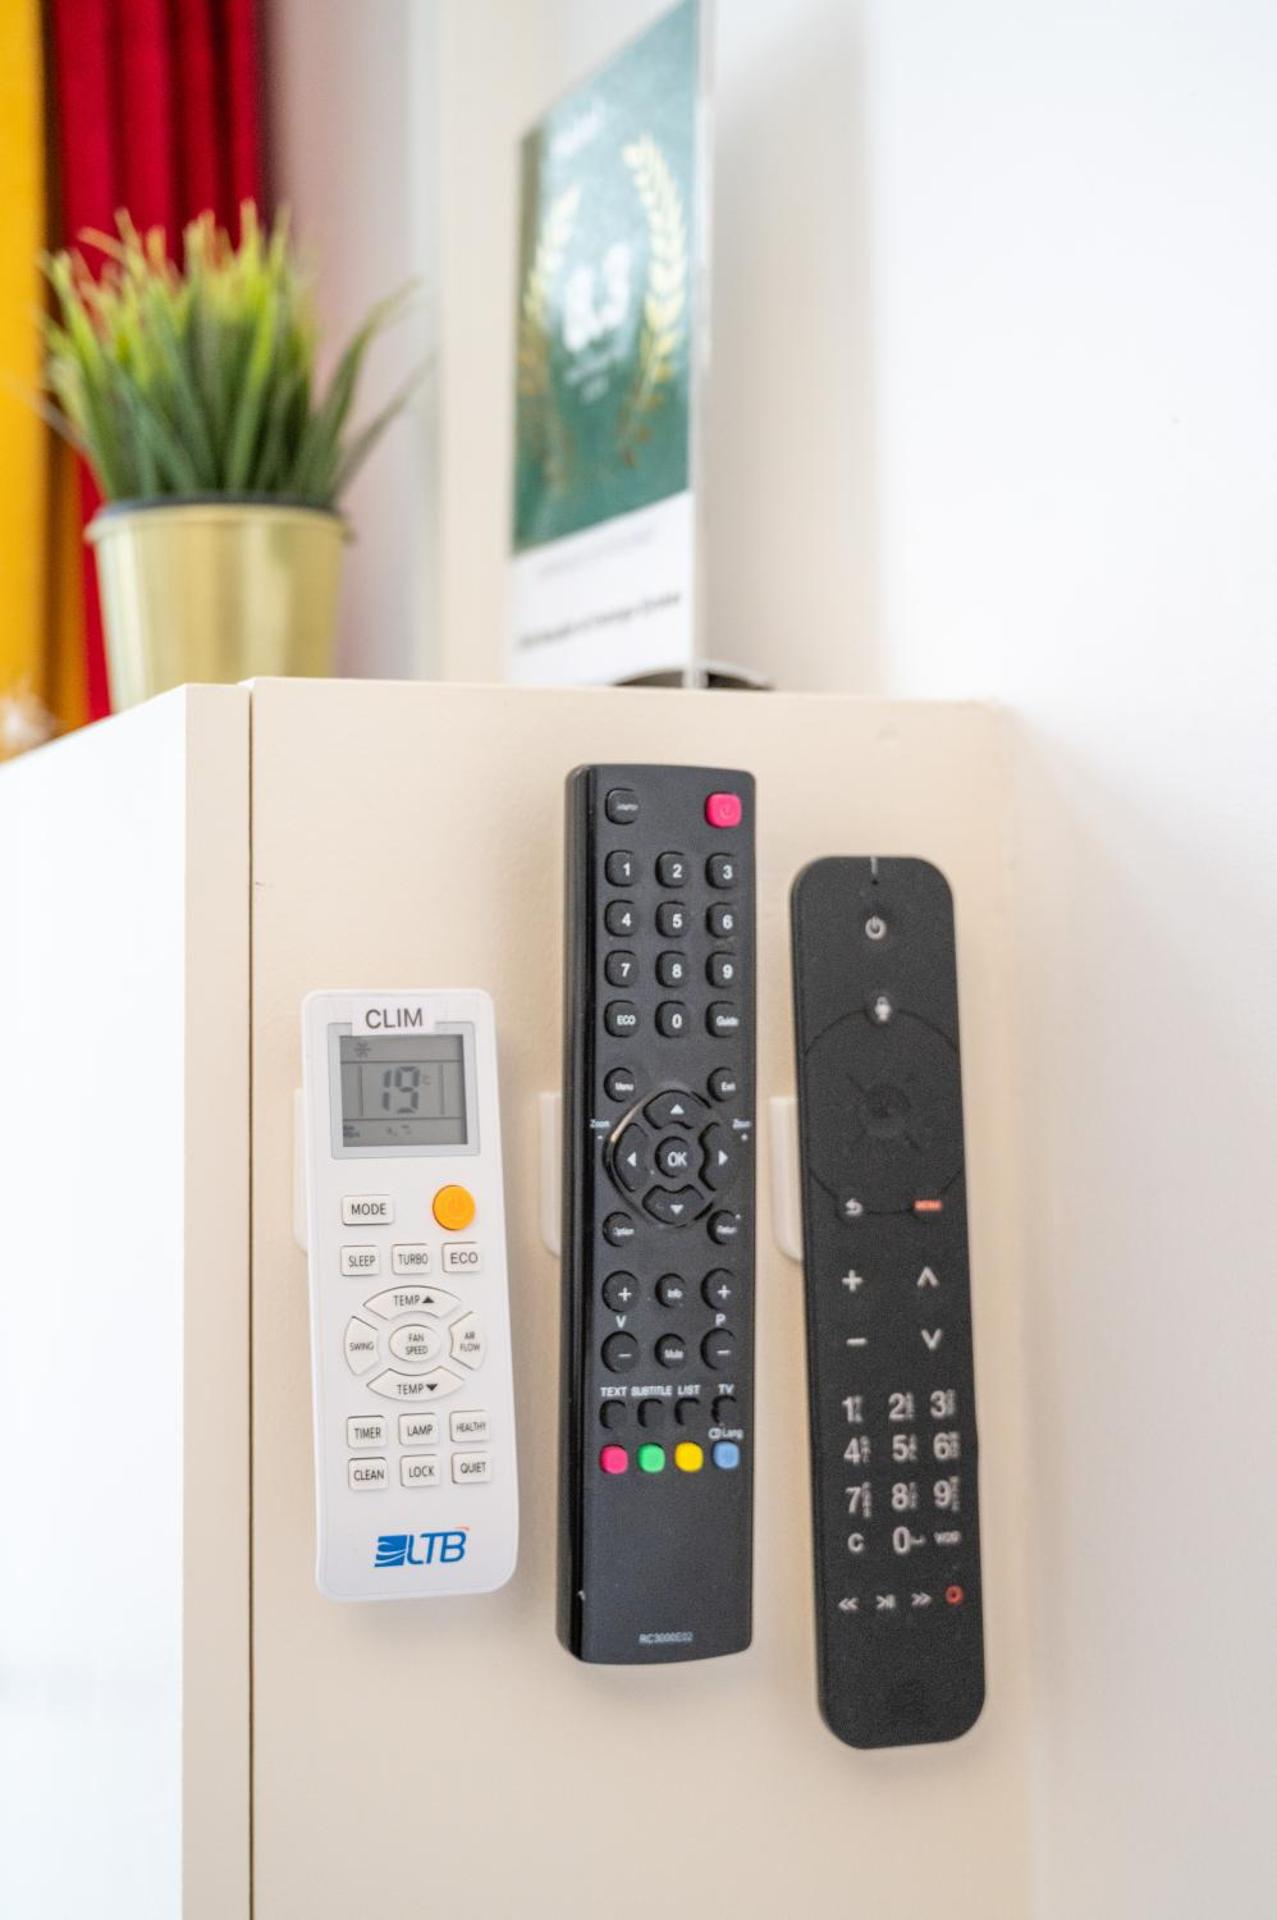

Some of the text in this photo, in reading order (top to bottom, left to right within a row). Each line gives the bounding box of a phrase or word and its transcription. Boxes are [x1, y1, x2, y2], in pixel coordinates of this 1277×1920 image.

[622, 862, 631, 877] 1
[672, 864, 683, 878] 2
[722, 865, 733, 880] 3
[621, 912, 632, 927] 4
[672, 913, 683, 928] 5
[722, 914, 733, 930] 6
[621, 962, 631, 977] 7
[672, 963, 682, 979] 8
[722, 964, 733, 979] 9
[364, 1007, 424, 1030] CLIM
[616, 1015, 636, 1026] ECO
[671, 1013, 682, 1029] 0
[382, 1065, 421, 1115] 19
[667, 1151, 688, 1167] OK
[351, 1202, 387, 1217] MODE
[348, 1254, 376, 1268] SLEEP
[398, 1252, 429, 1266] TURBO
[450, 1251, 478, 1265] ECO
[393, 1294, 420, 1307] TEMP
[615, 1315, 627, 1328] V
[715, 1313, 727, 1327] P
[408, 1333, 425, 1343] FAN
[349, 1341, 375, 1352] SWING
[405, 1344, 428, 1356] SPEED
[459, 1342, 481, 1353] FLOW
[397, 1383, 425, 1396] TEMP
[600, 1383, 734, 1397] TEXT SUBTITLE LIST TV
[888, 1392, 906, 1420] 2
[929, 1389, 946, 1419] 3
[354, 1426, 382, 1440] TIMER
[406, 1423, 434, 1437] LAMP
[456, 1421, 487, 1434] HEALTHY
[843, 1437, 861, 1465] 4
[892, 1434, 909, 1462] 5
[933, 1432, 949, 1461] 6
[353, 1467, 385, 1482] CLEAN
[408, 1464, 435, 1478] LOCK
[460, 1461, 487, 1475] QUIET
[845, 1486, 862, 1514] 7
[891, 1482, 909, 1511] 8
[933, 1480, 951, 1509] 9
[892, 1526, 911, 1554] 0
[405, 1530, 468, 1566] LTB
